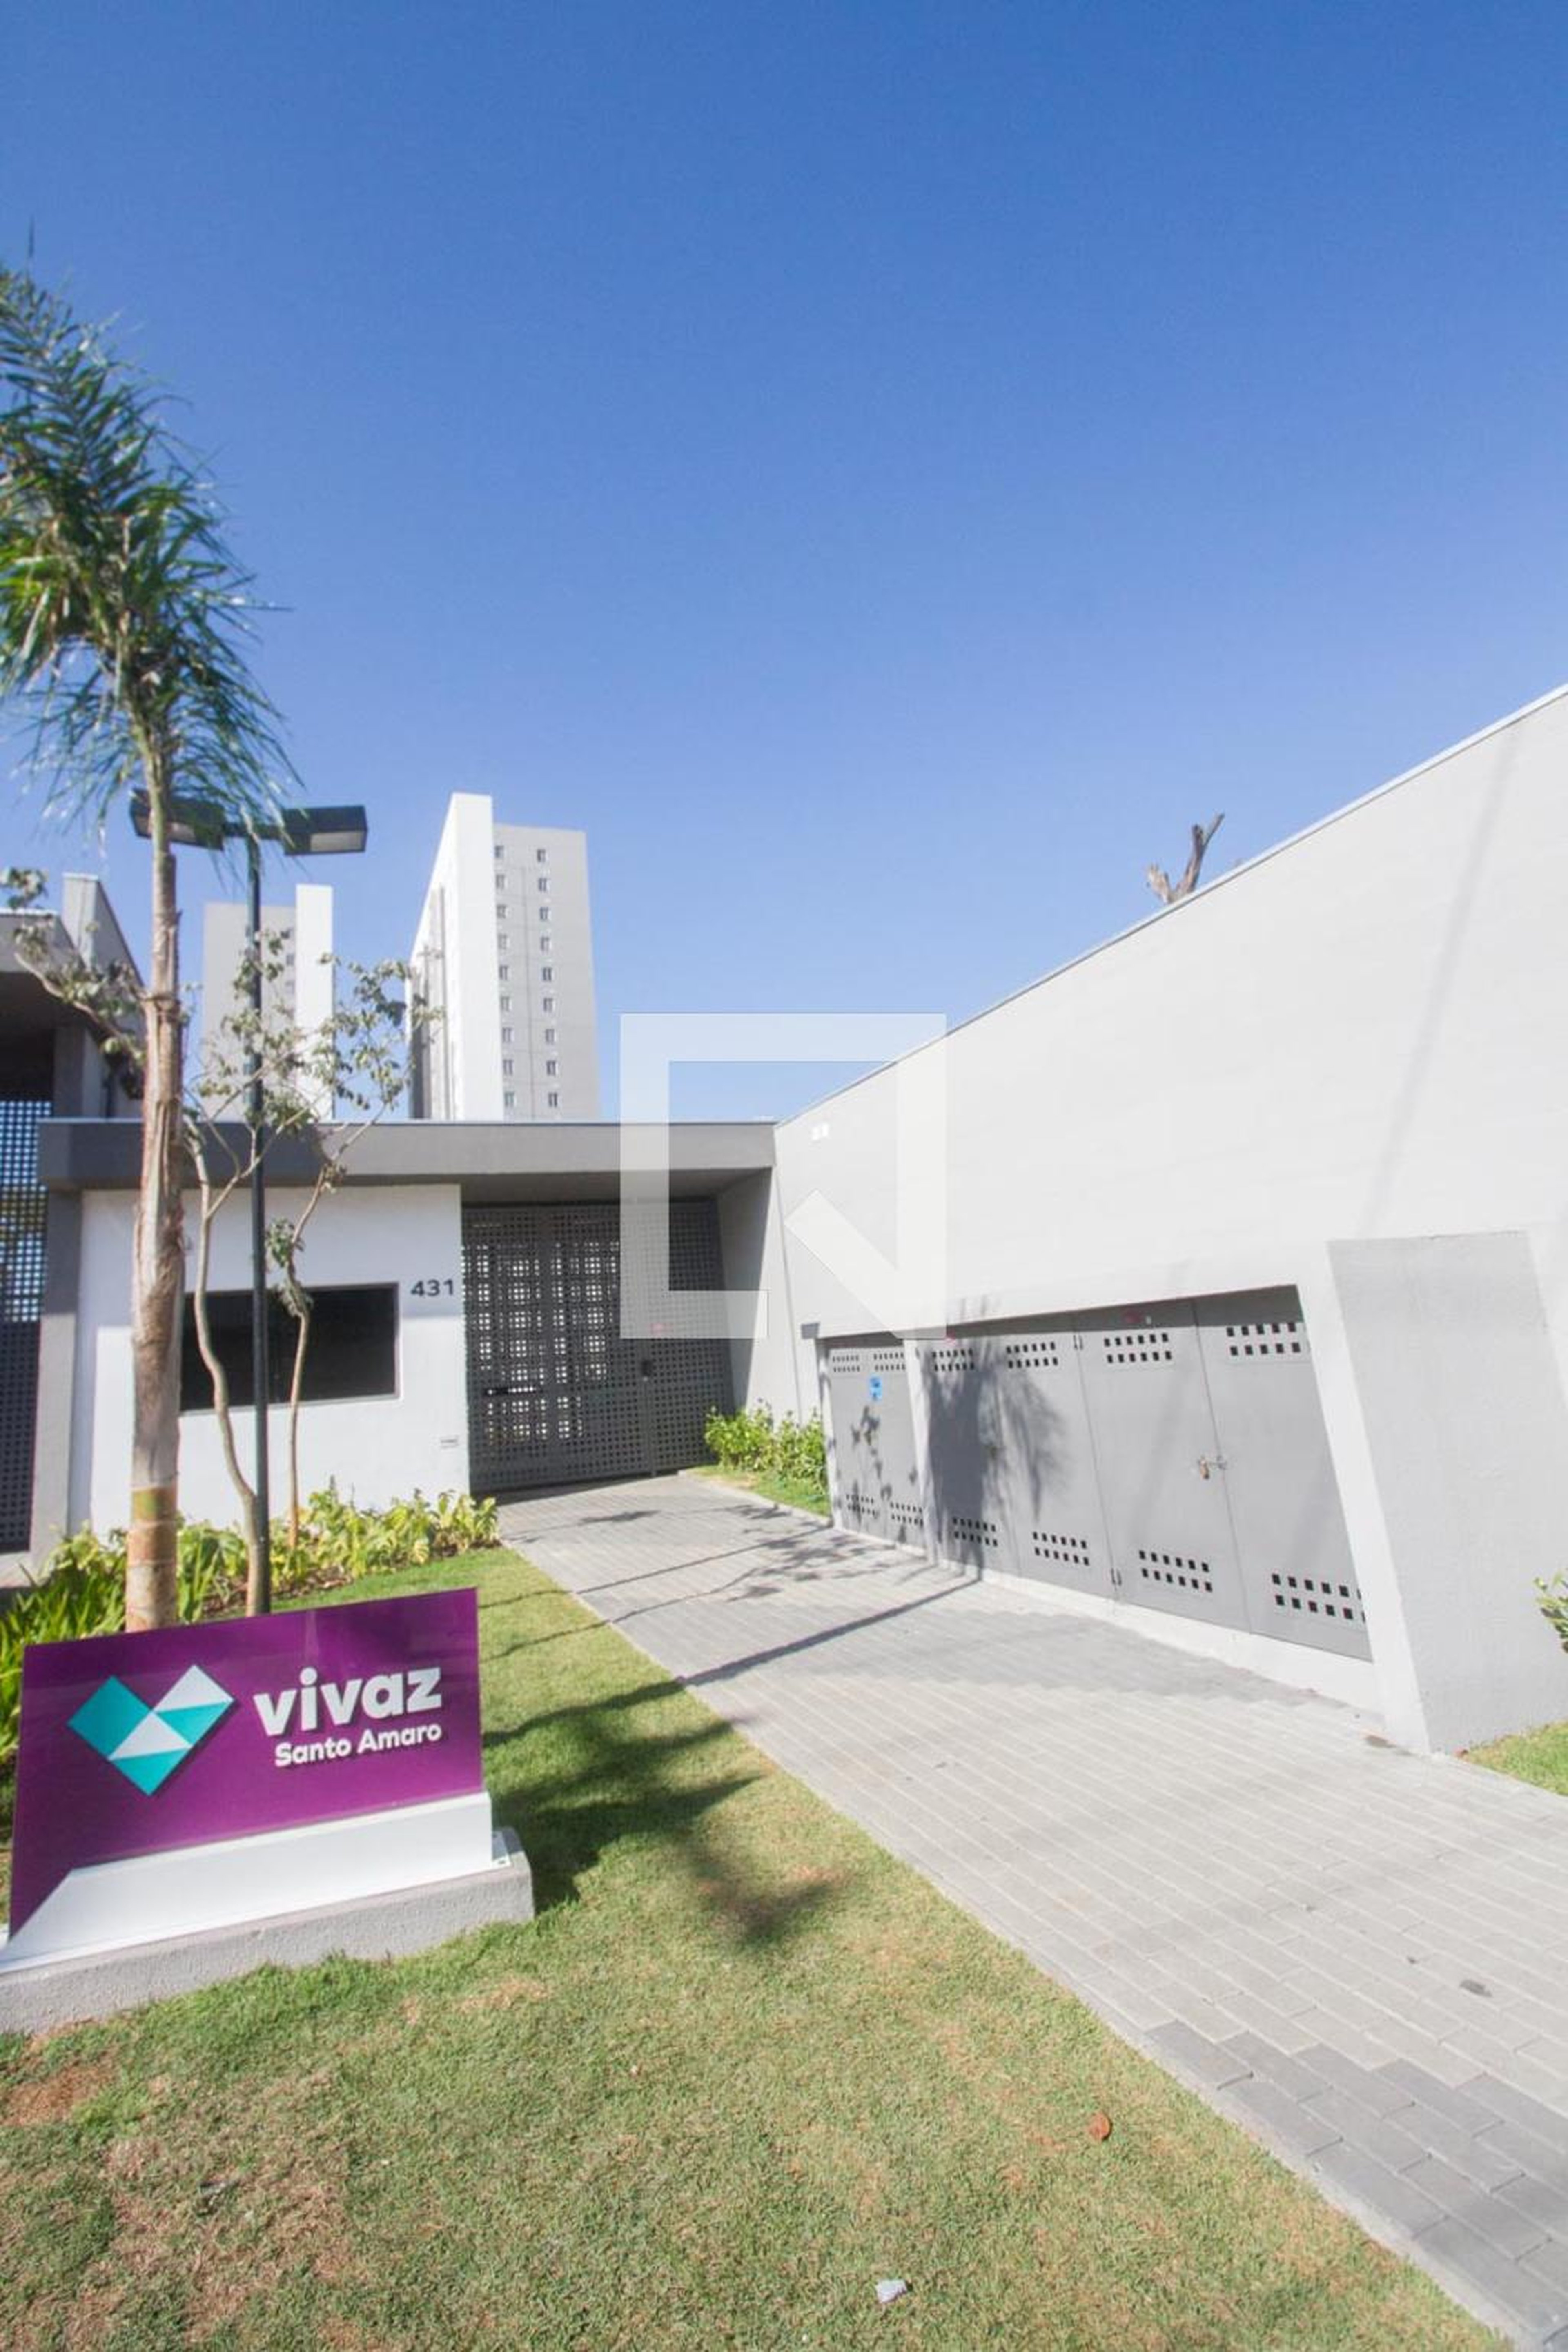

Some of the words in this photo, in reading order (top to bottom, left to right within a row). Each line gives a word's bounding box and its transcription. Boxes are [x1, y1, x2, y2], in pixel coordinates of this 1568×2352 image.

[410, 1278, 454, 1297] 431
[253, 1667, 442, 1737] vivaz
[275, 1737, 352, 1767] Santo
[357, 1724, 442, 1754] Amaro
